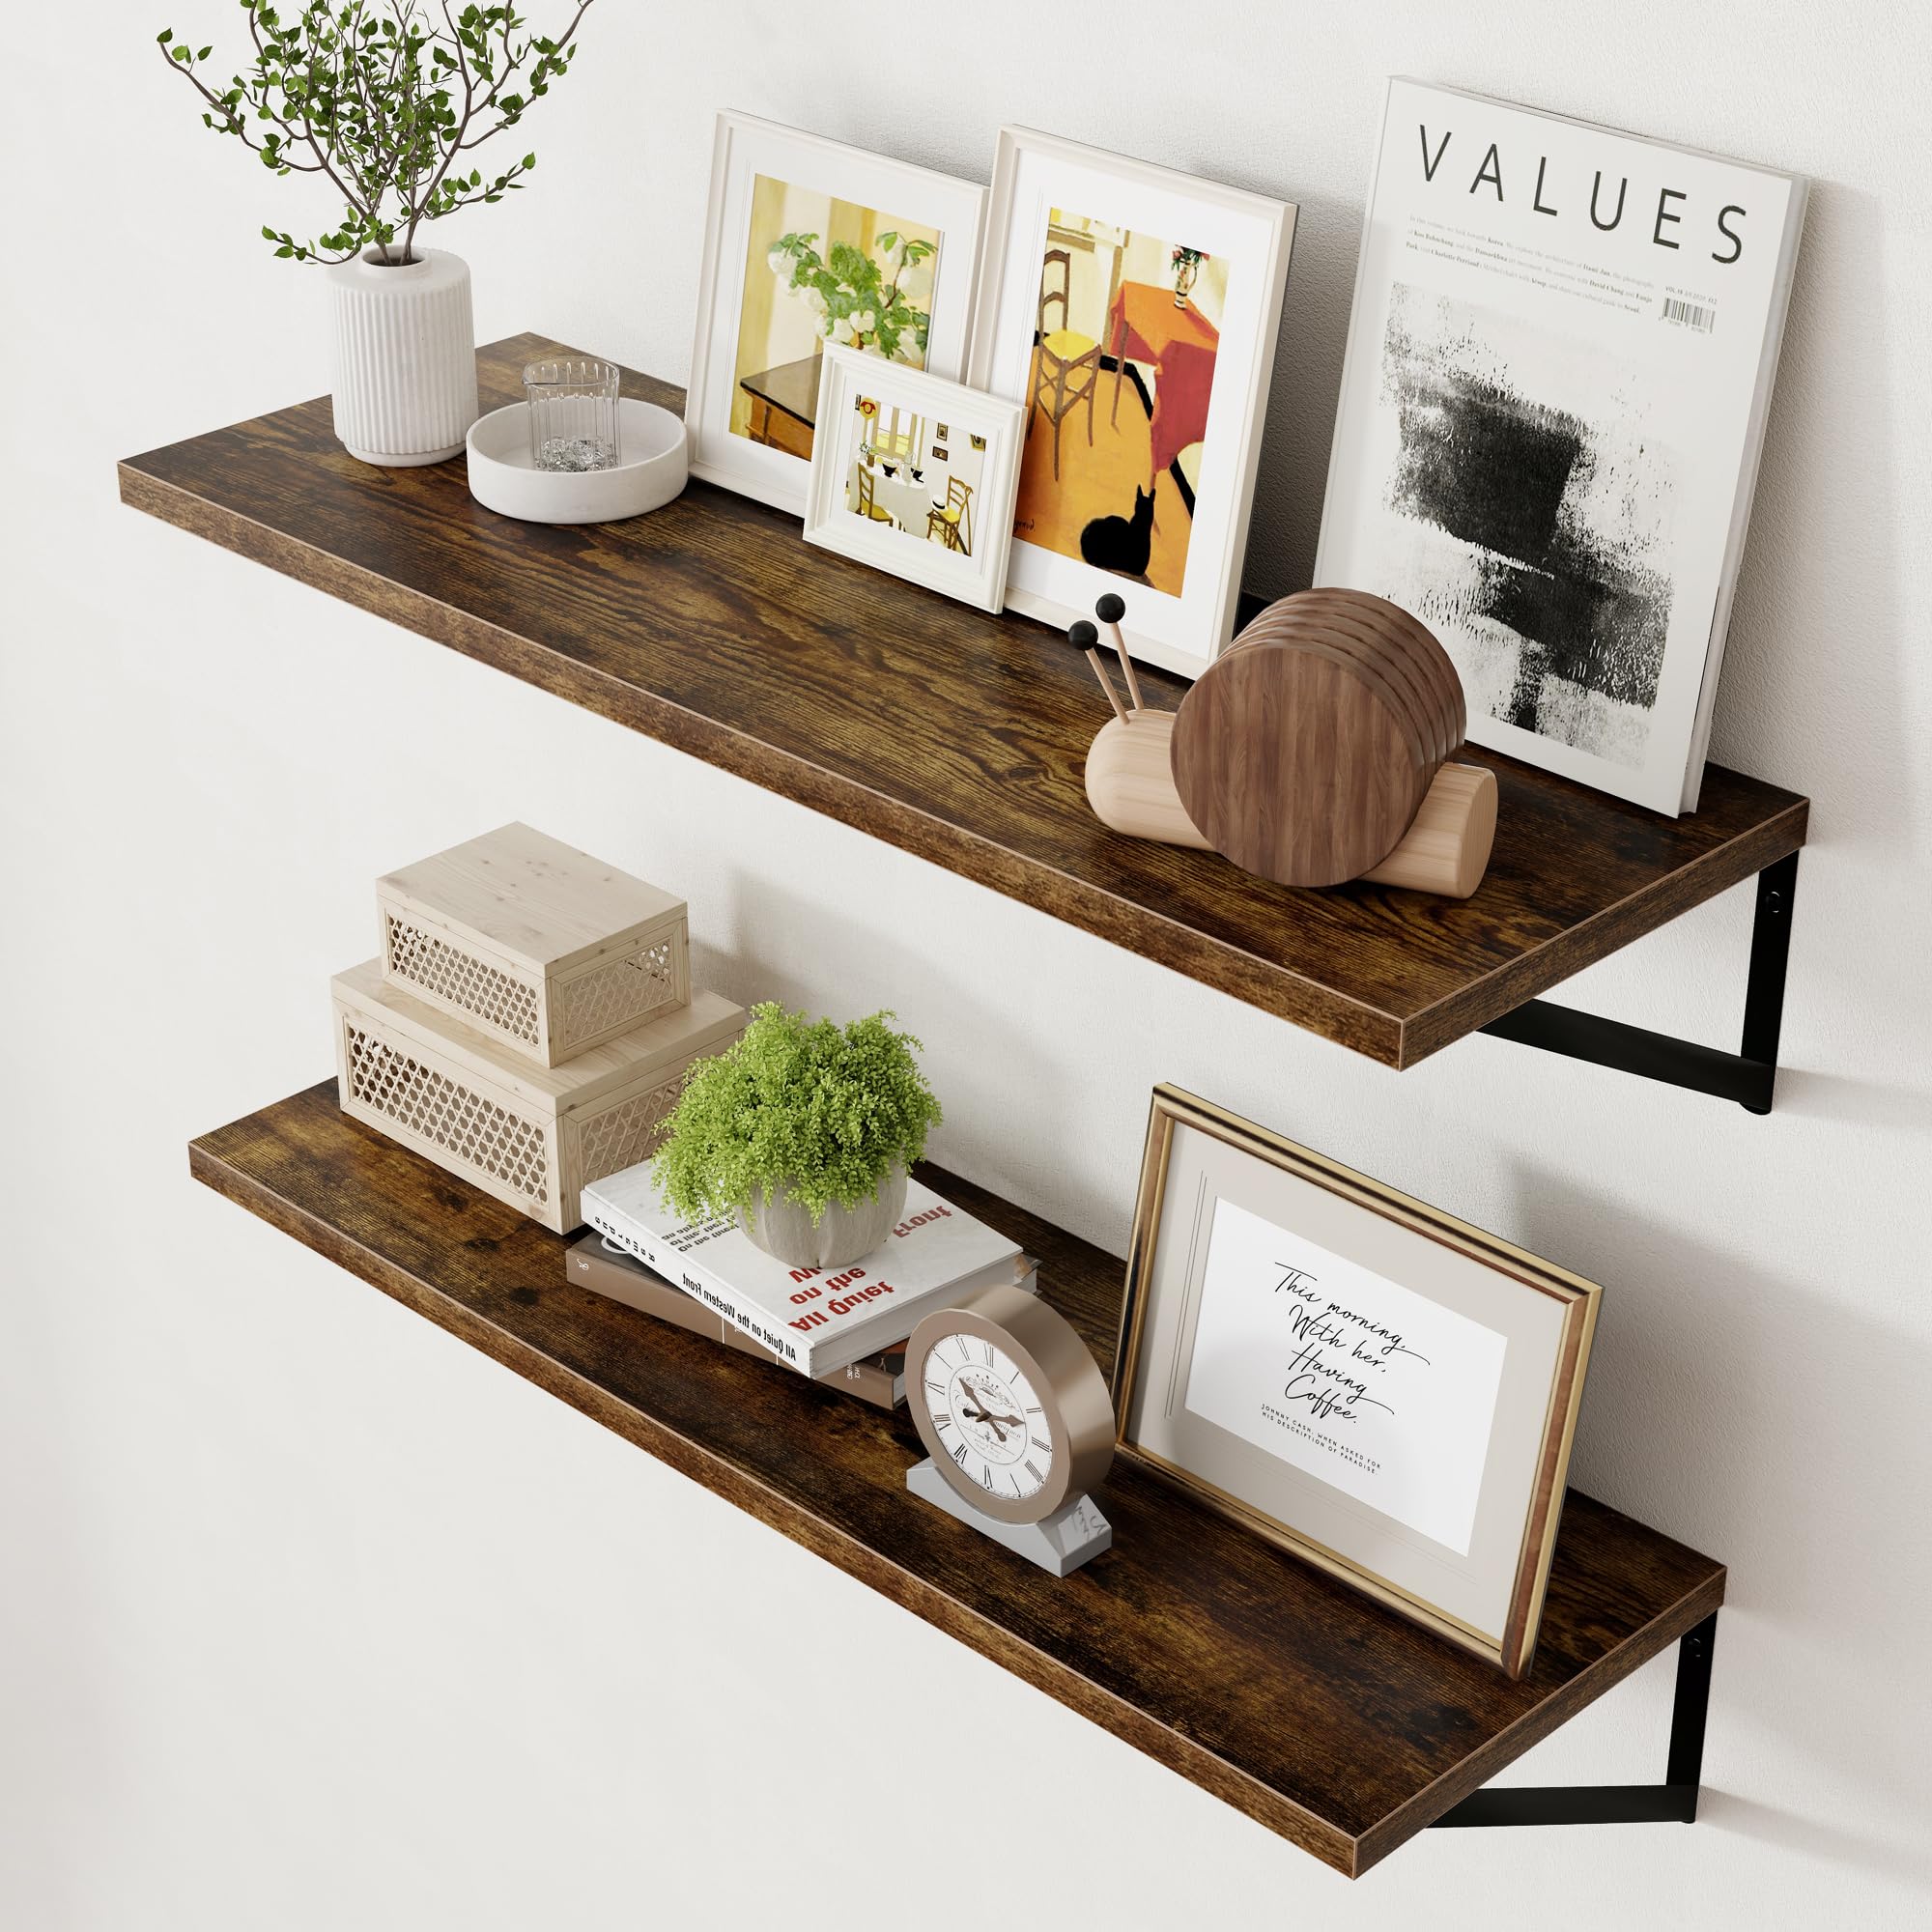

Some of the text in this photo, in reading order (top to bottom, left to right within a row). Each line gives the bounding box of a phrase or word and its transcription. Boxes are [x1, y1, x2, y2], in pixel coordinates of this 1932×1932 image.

[1419, 124, 1747, 265] VALUES
[1274, 1262, 1321, 1302] This
[1289, 1304, 1347, 1348] With
[1288, 1342, 1395, 1415] Having
[1261, 1404, 1290, 1421] JOHNNY
[1317, 1433, 1338, 1447] WHEN
[1340, 1445, 1364, 1461] ASKED
[1367, 1459, 1381, 1469] FOR
[1262, 1411, 1274, 1421] HIS
[1277, 1419, 1324, 1447] DESCRIPTION
[1327, 1445, 1337, 1454] OF
